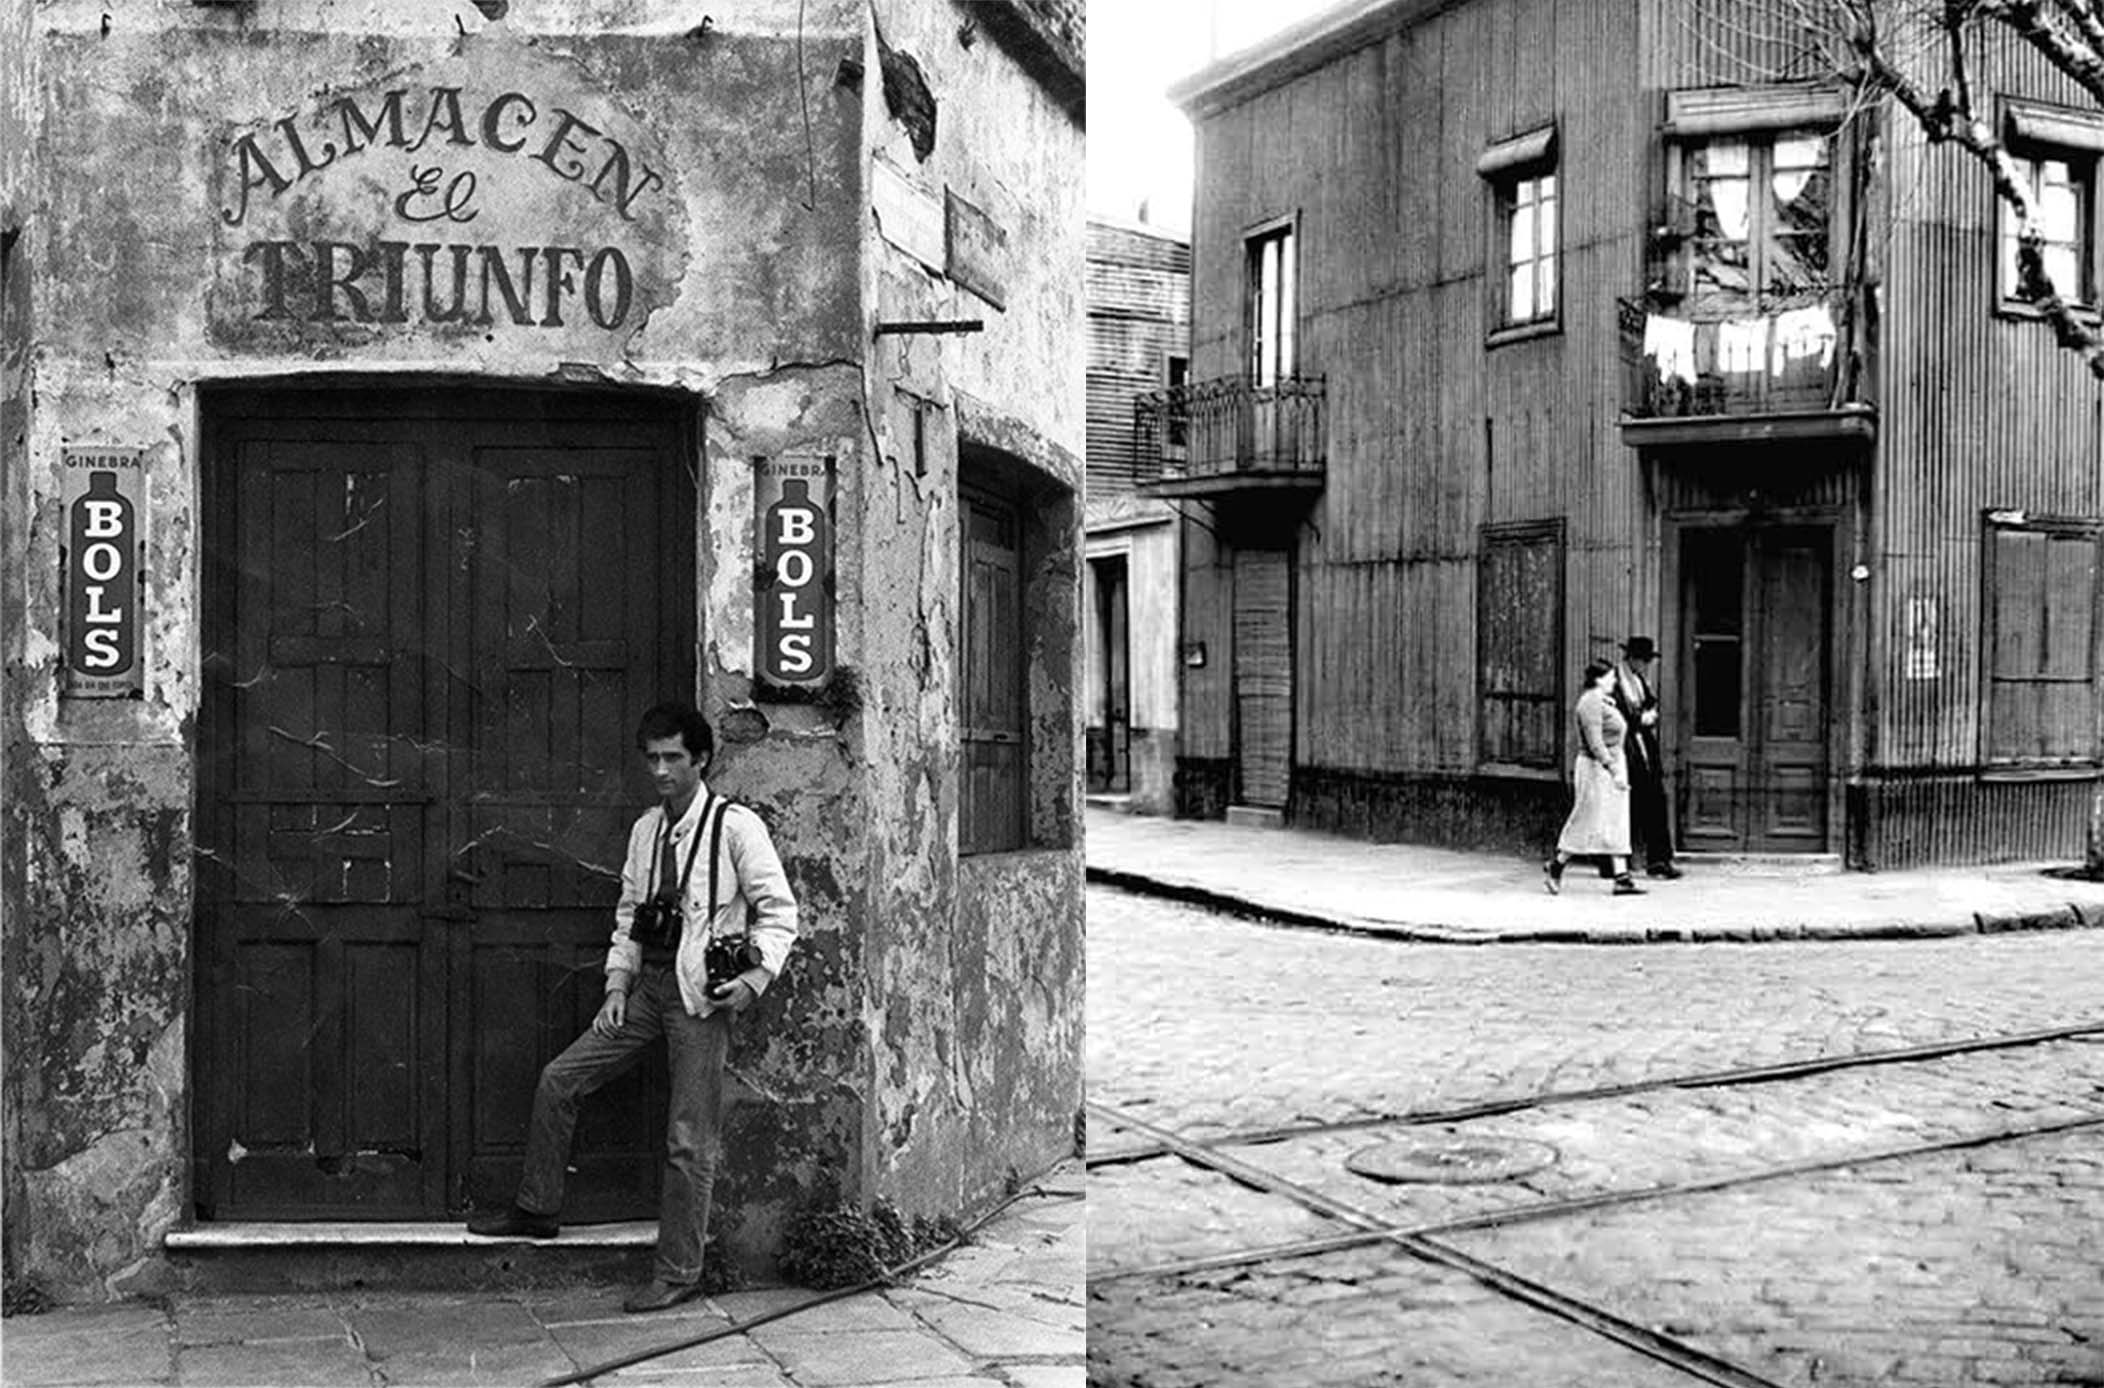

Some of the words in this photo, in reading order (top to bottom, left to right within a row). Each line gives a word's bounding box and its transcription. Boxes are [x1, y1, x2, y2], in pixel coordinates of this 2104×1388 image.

[221, 86, 663, 227] ALMACEN
[394, 163, 479, 223] El
[242, 240, 634, 331] TRIUNFO
[65, 455, 141, 469] GINEBRA
[83, 500, 123, 668] BOLS
[776, 508, 815, 673] BOLS
